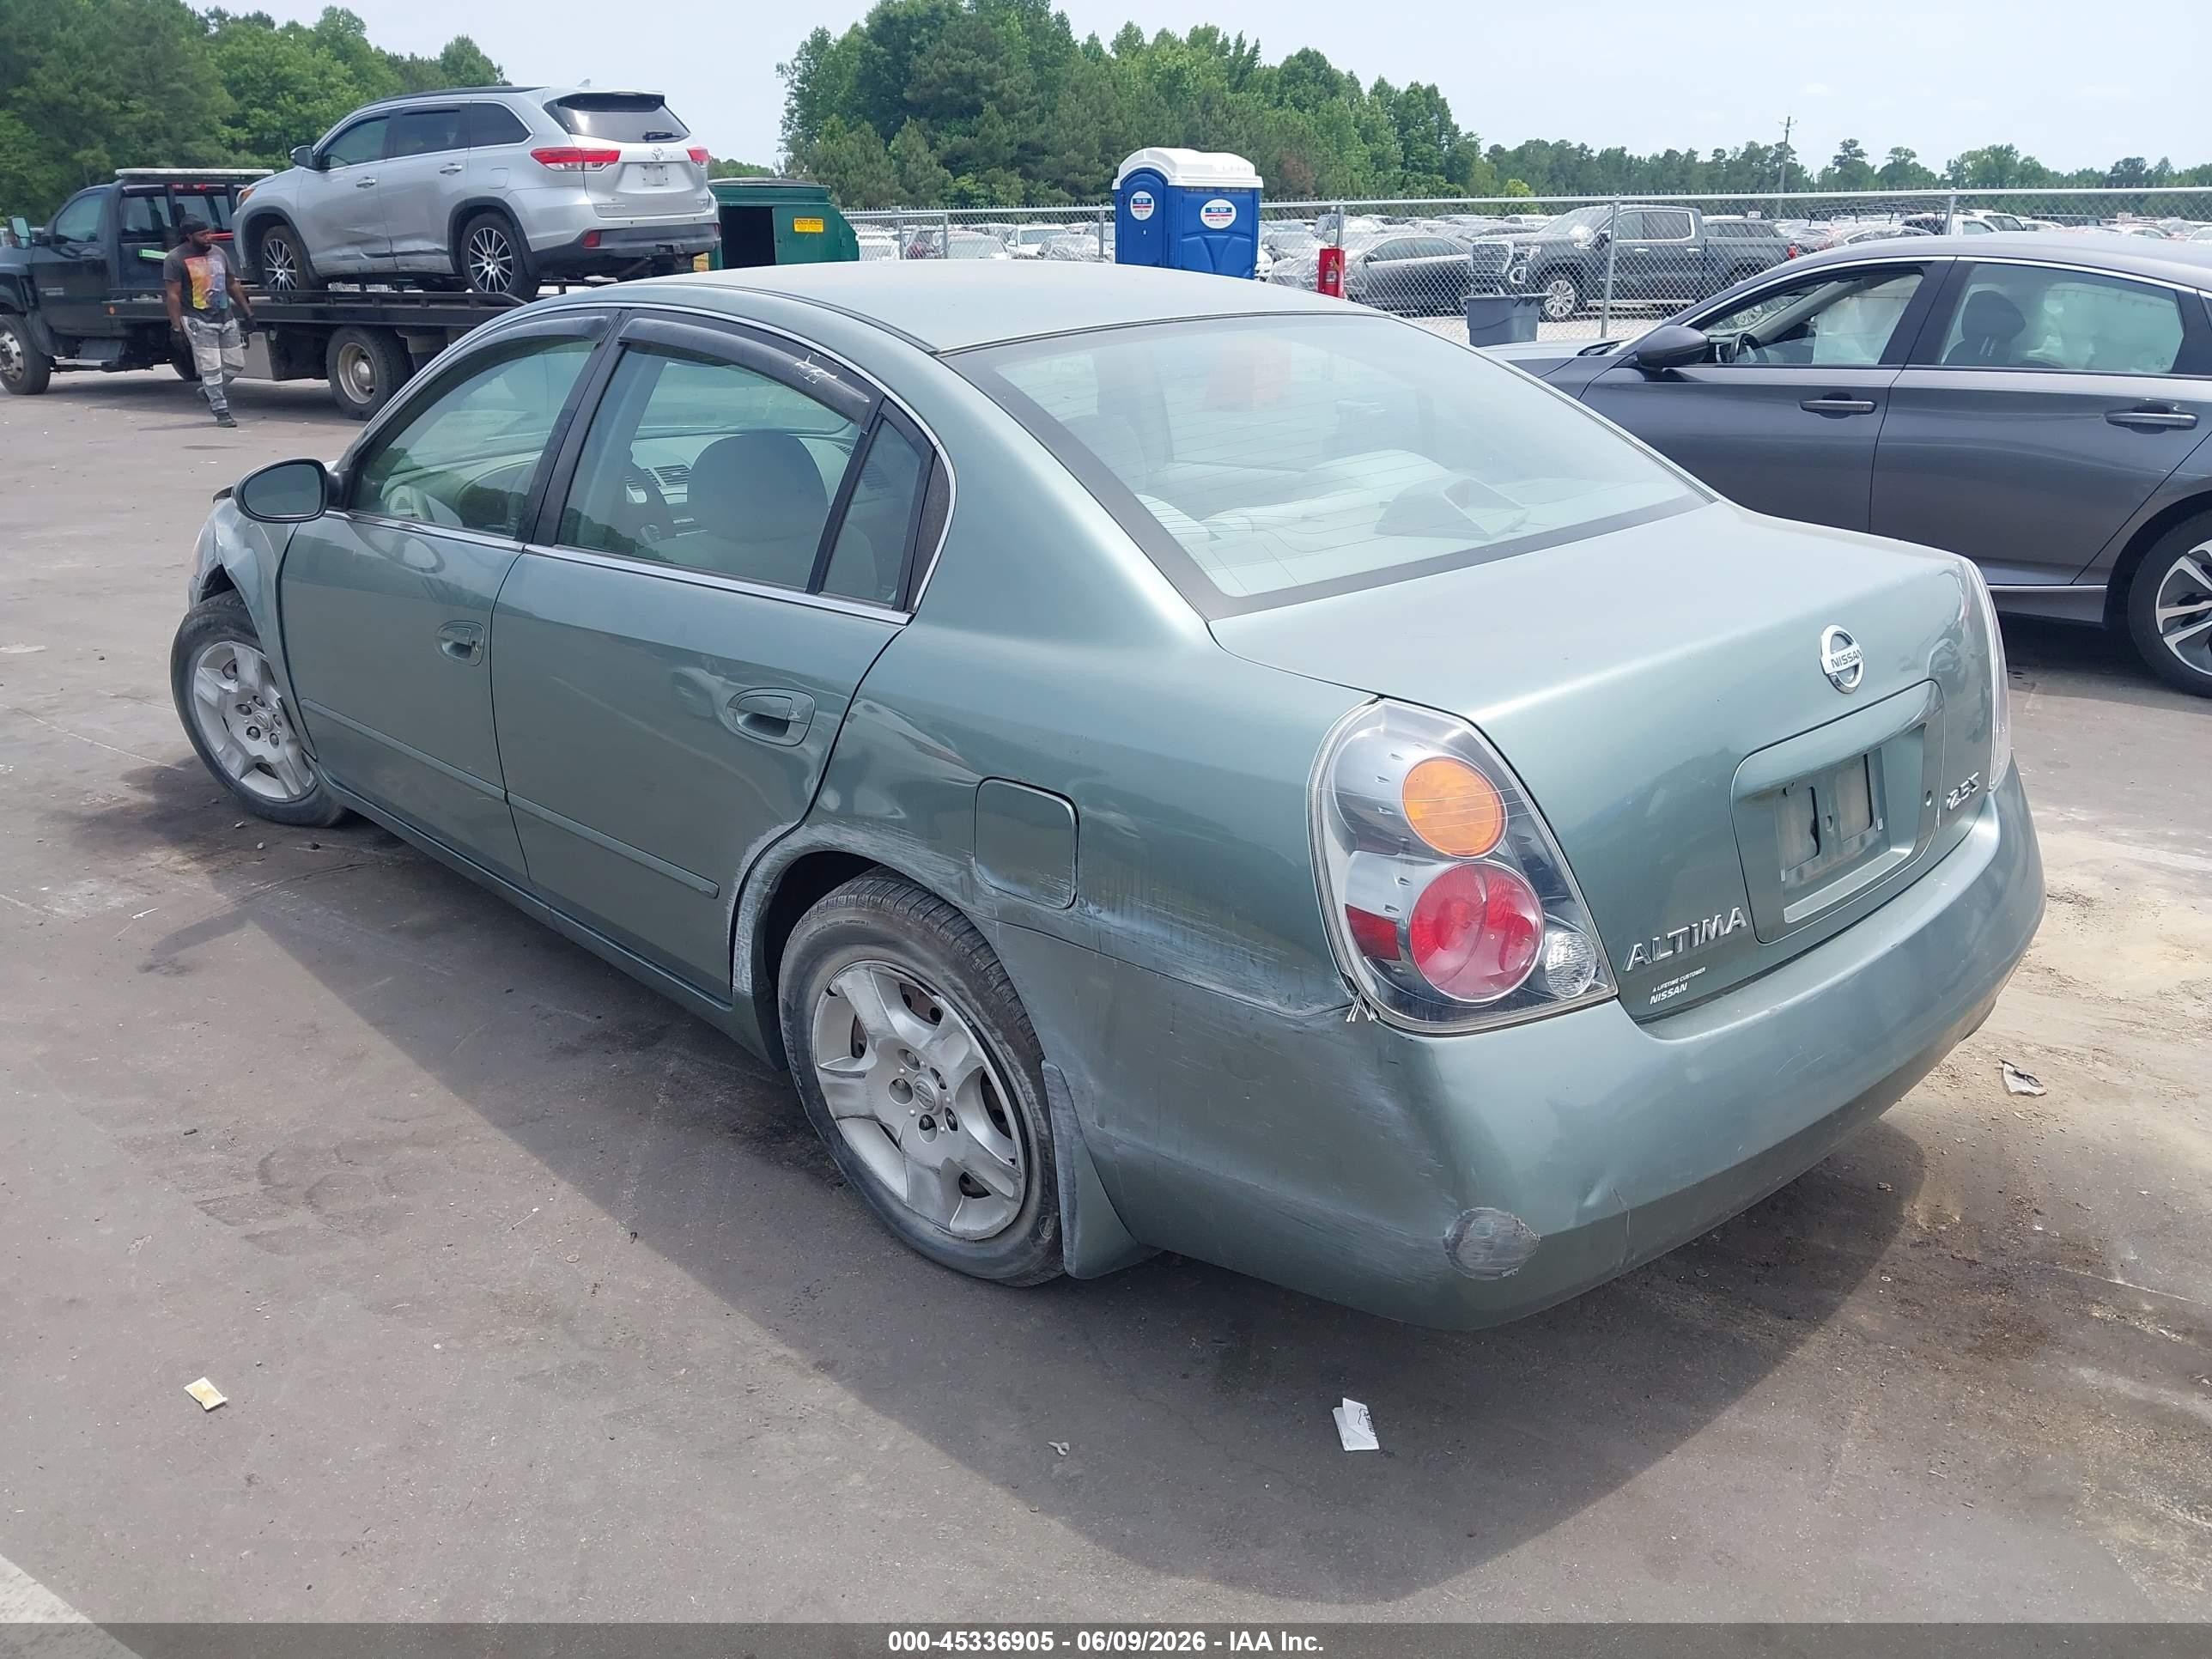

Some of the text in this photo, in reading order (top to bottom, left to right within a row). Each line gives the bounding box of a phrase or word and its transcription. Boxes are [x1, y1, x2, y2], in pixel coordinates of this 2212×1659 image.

[1830, 649, 1863, 668] NISSAN
[1622, 906, 1747, 972] ALTIMA
[1656, 977, 1680, 991] LIFETIME
[1680, 966, 1706, 982] CUSTOMER
[1649, 981, 1688, 1006] NISSAN
